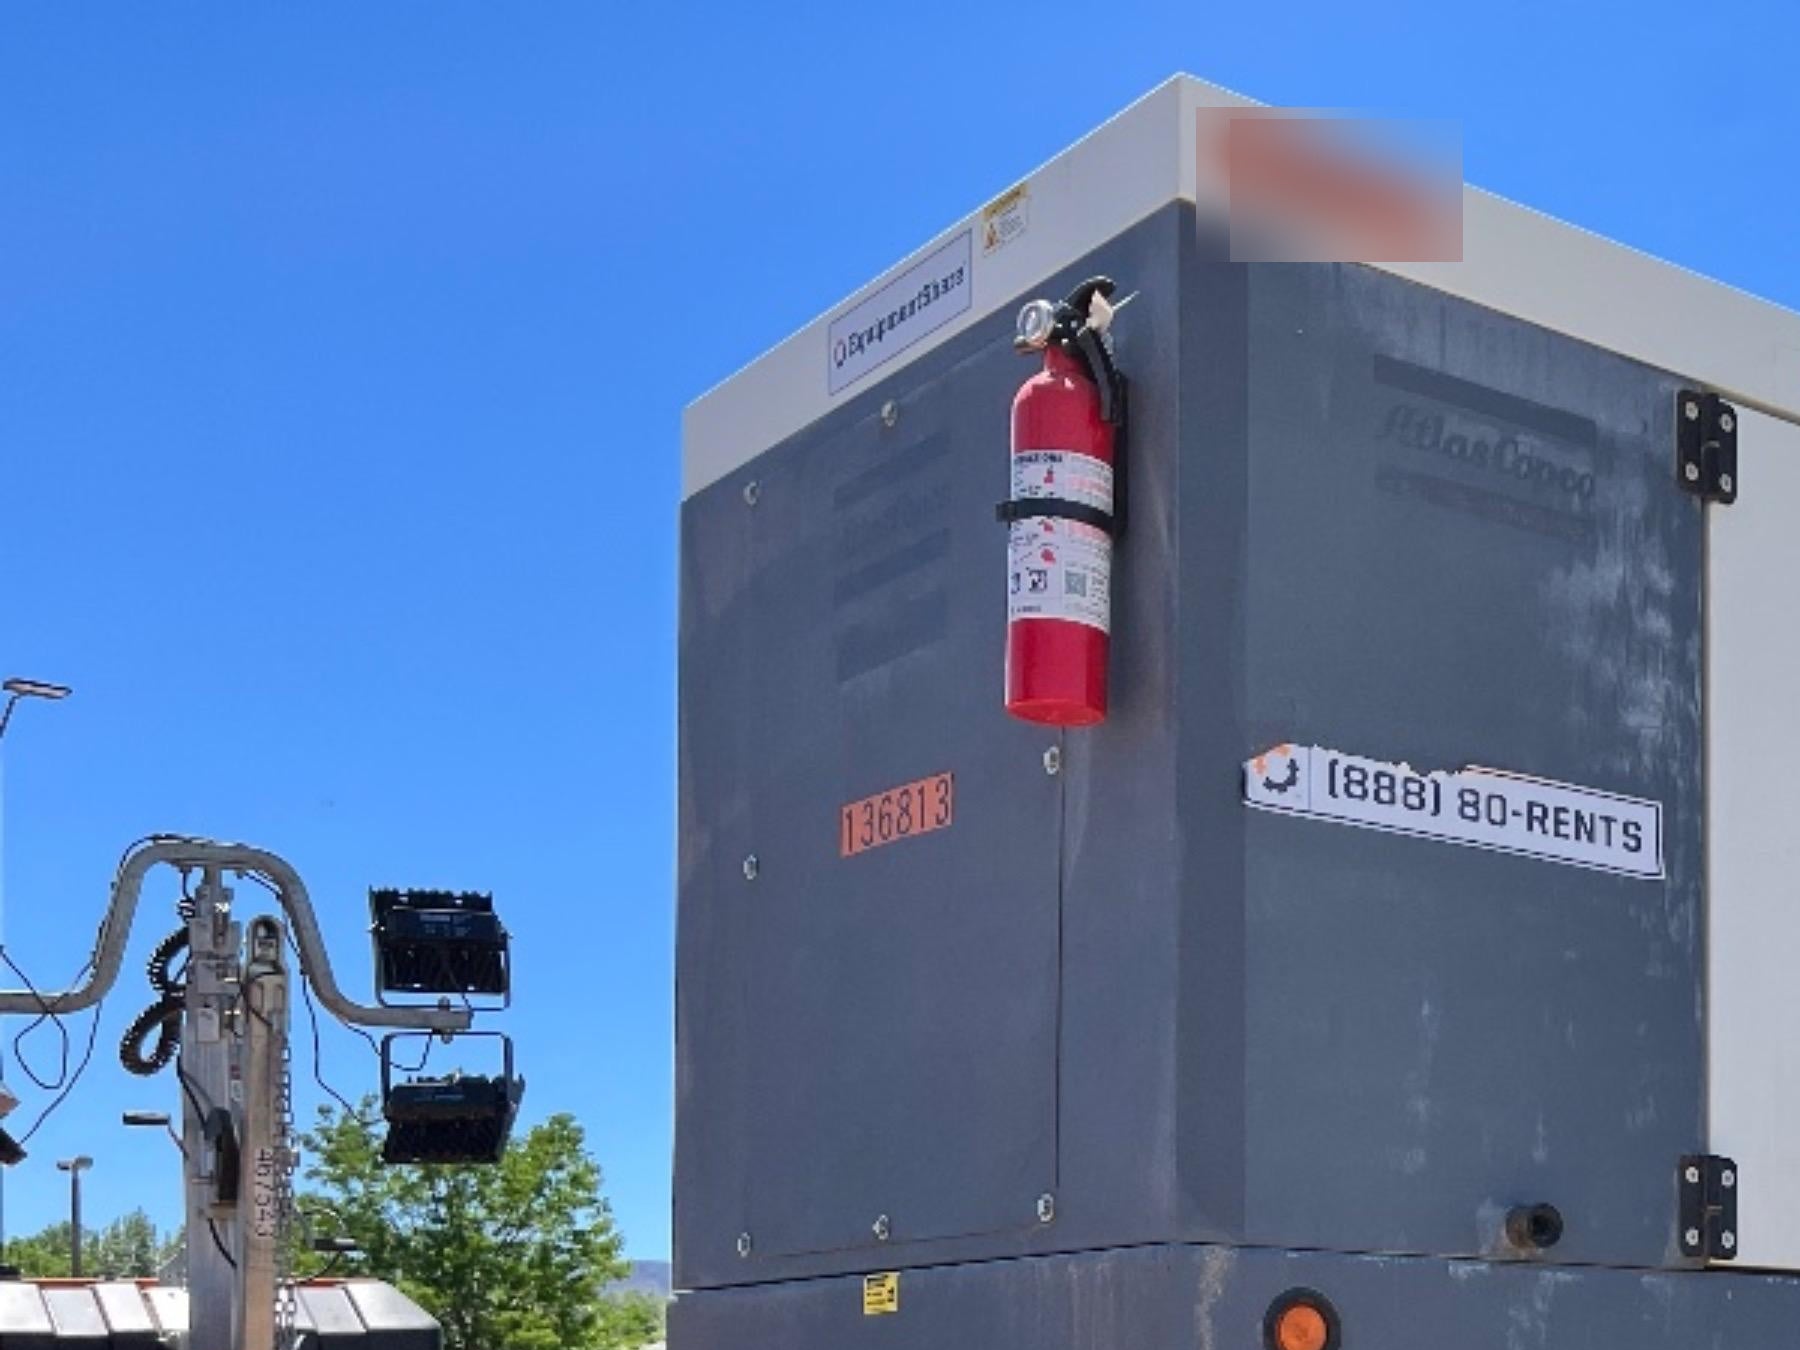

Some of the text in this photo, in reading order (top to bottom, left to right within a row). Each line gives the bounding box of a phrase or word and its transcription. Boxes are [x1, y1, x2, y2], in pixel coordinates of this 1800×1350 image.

[848, 265, 965, 358] EquipmentShare
[845, 779, 949, 853] 136813
[1328, 758, 1643, 853] (888) 80-RENTS
